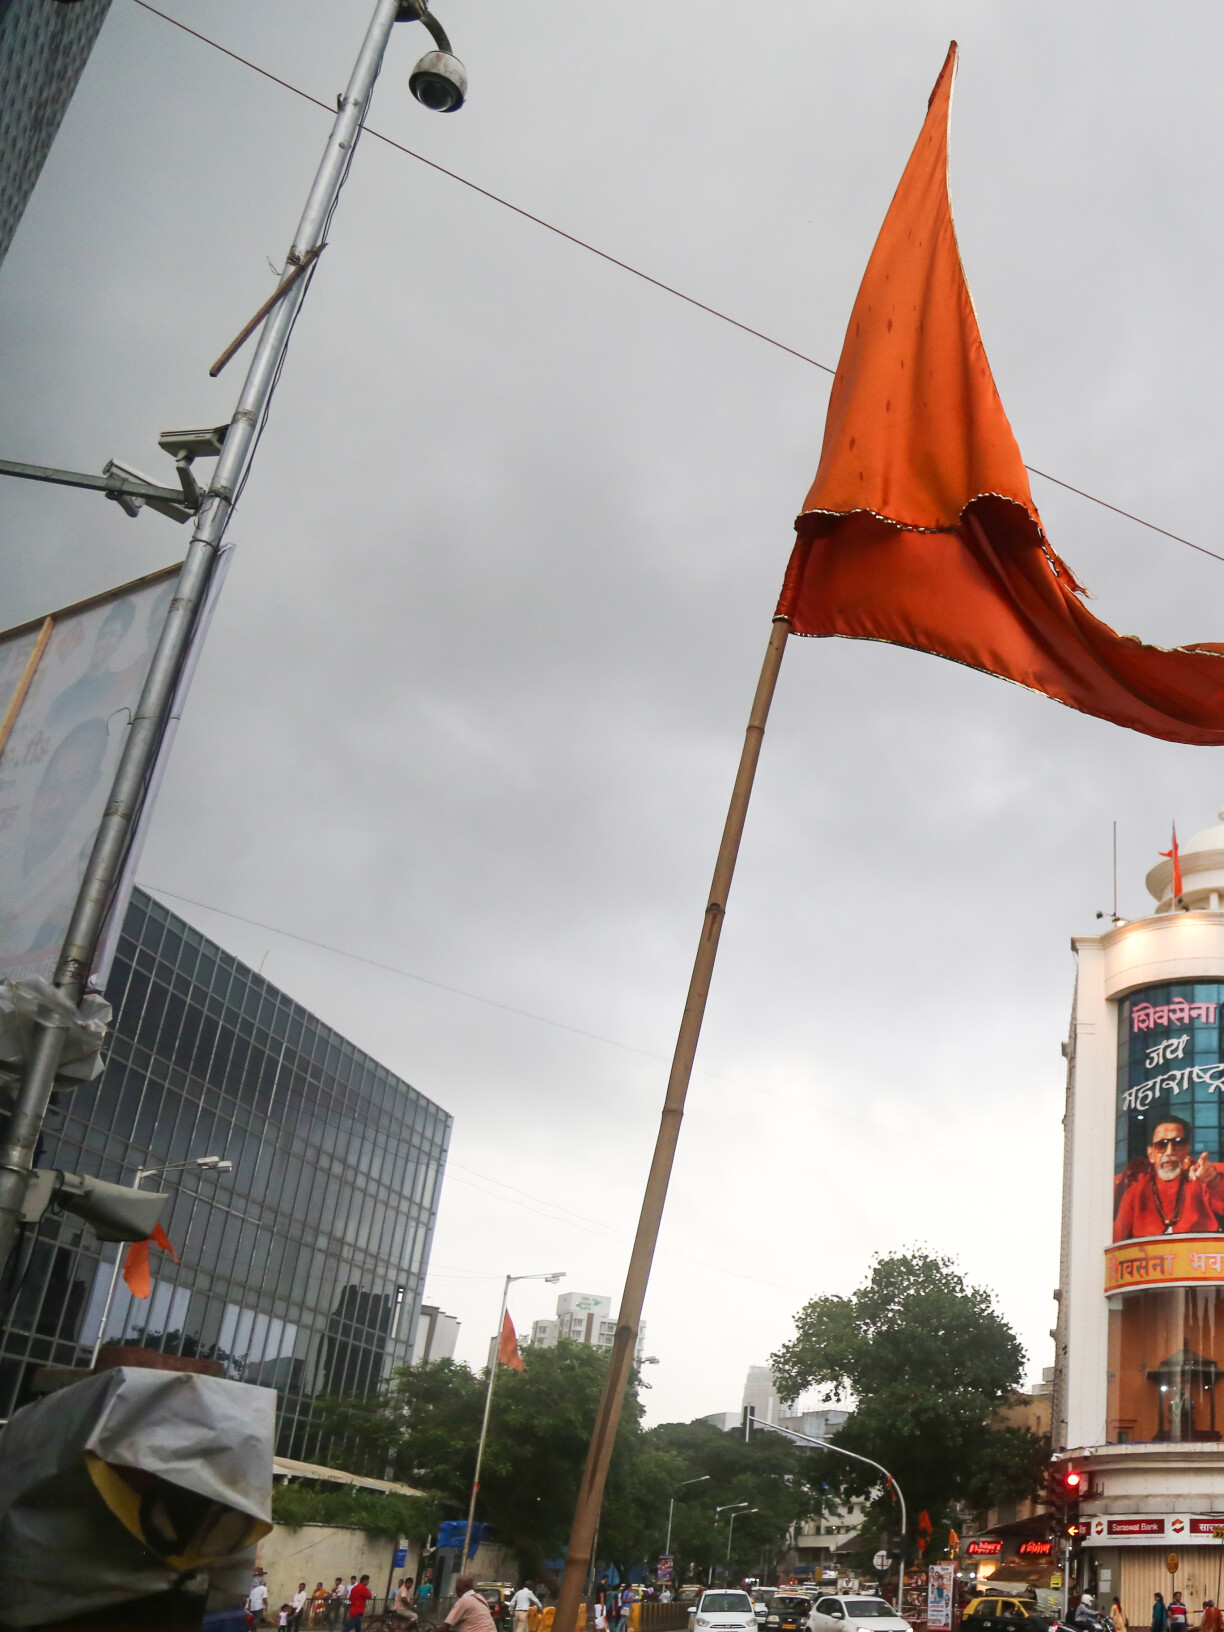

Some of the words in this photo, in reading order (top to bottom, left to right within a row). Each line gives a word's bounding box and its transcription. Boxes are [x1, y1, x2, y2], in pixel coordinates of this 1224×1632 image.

[1132, 997, 1217, 1032] शिवसेना
[1145, 1034, 1190, 1069] जय
[1109, 1246, 1176, 1282] शिवसेना
[1111, 1523, 1140, 1532] Saraswat
[1141, 1522, 1159, 1531] Bank
